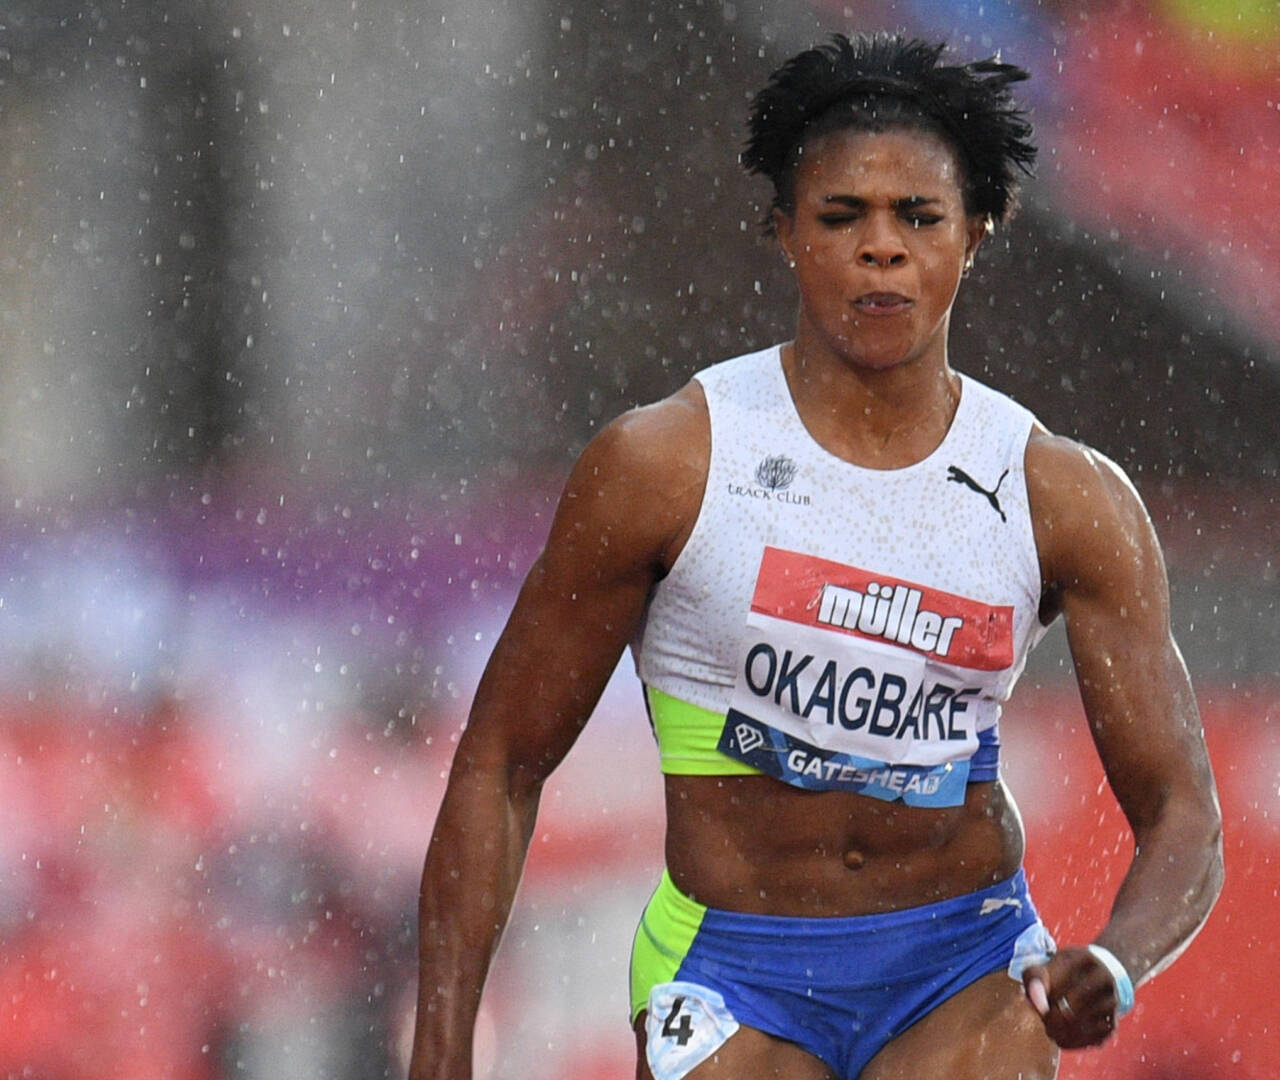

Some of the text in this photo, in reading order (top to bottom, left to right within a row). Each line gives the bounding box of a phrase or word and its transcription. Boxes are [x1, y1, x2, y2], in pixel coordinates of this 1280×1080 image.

[776, 491, 811, 506] CLUB
[816, 581, 963, 657] müller
[744, 643, 982, 741] OKAGBARE
[787, 750, 940, 795] GATESHEAD
[661, 996, 694, 1046] 4
